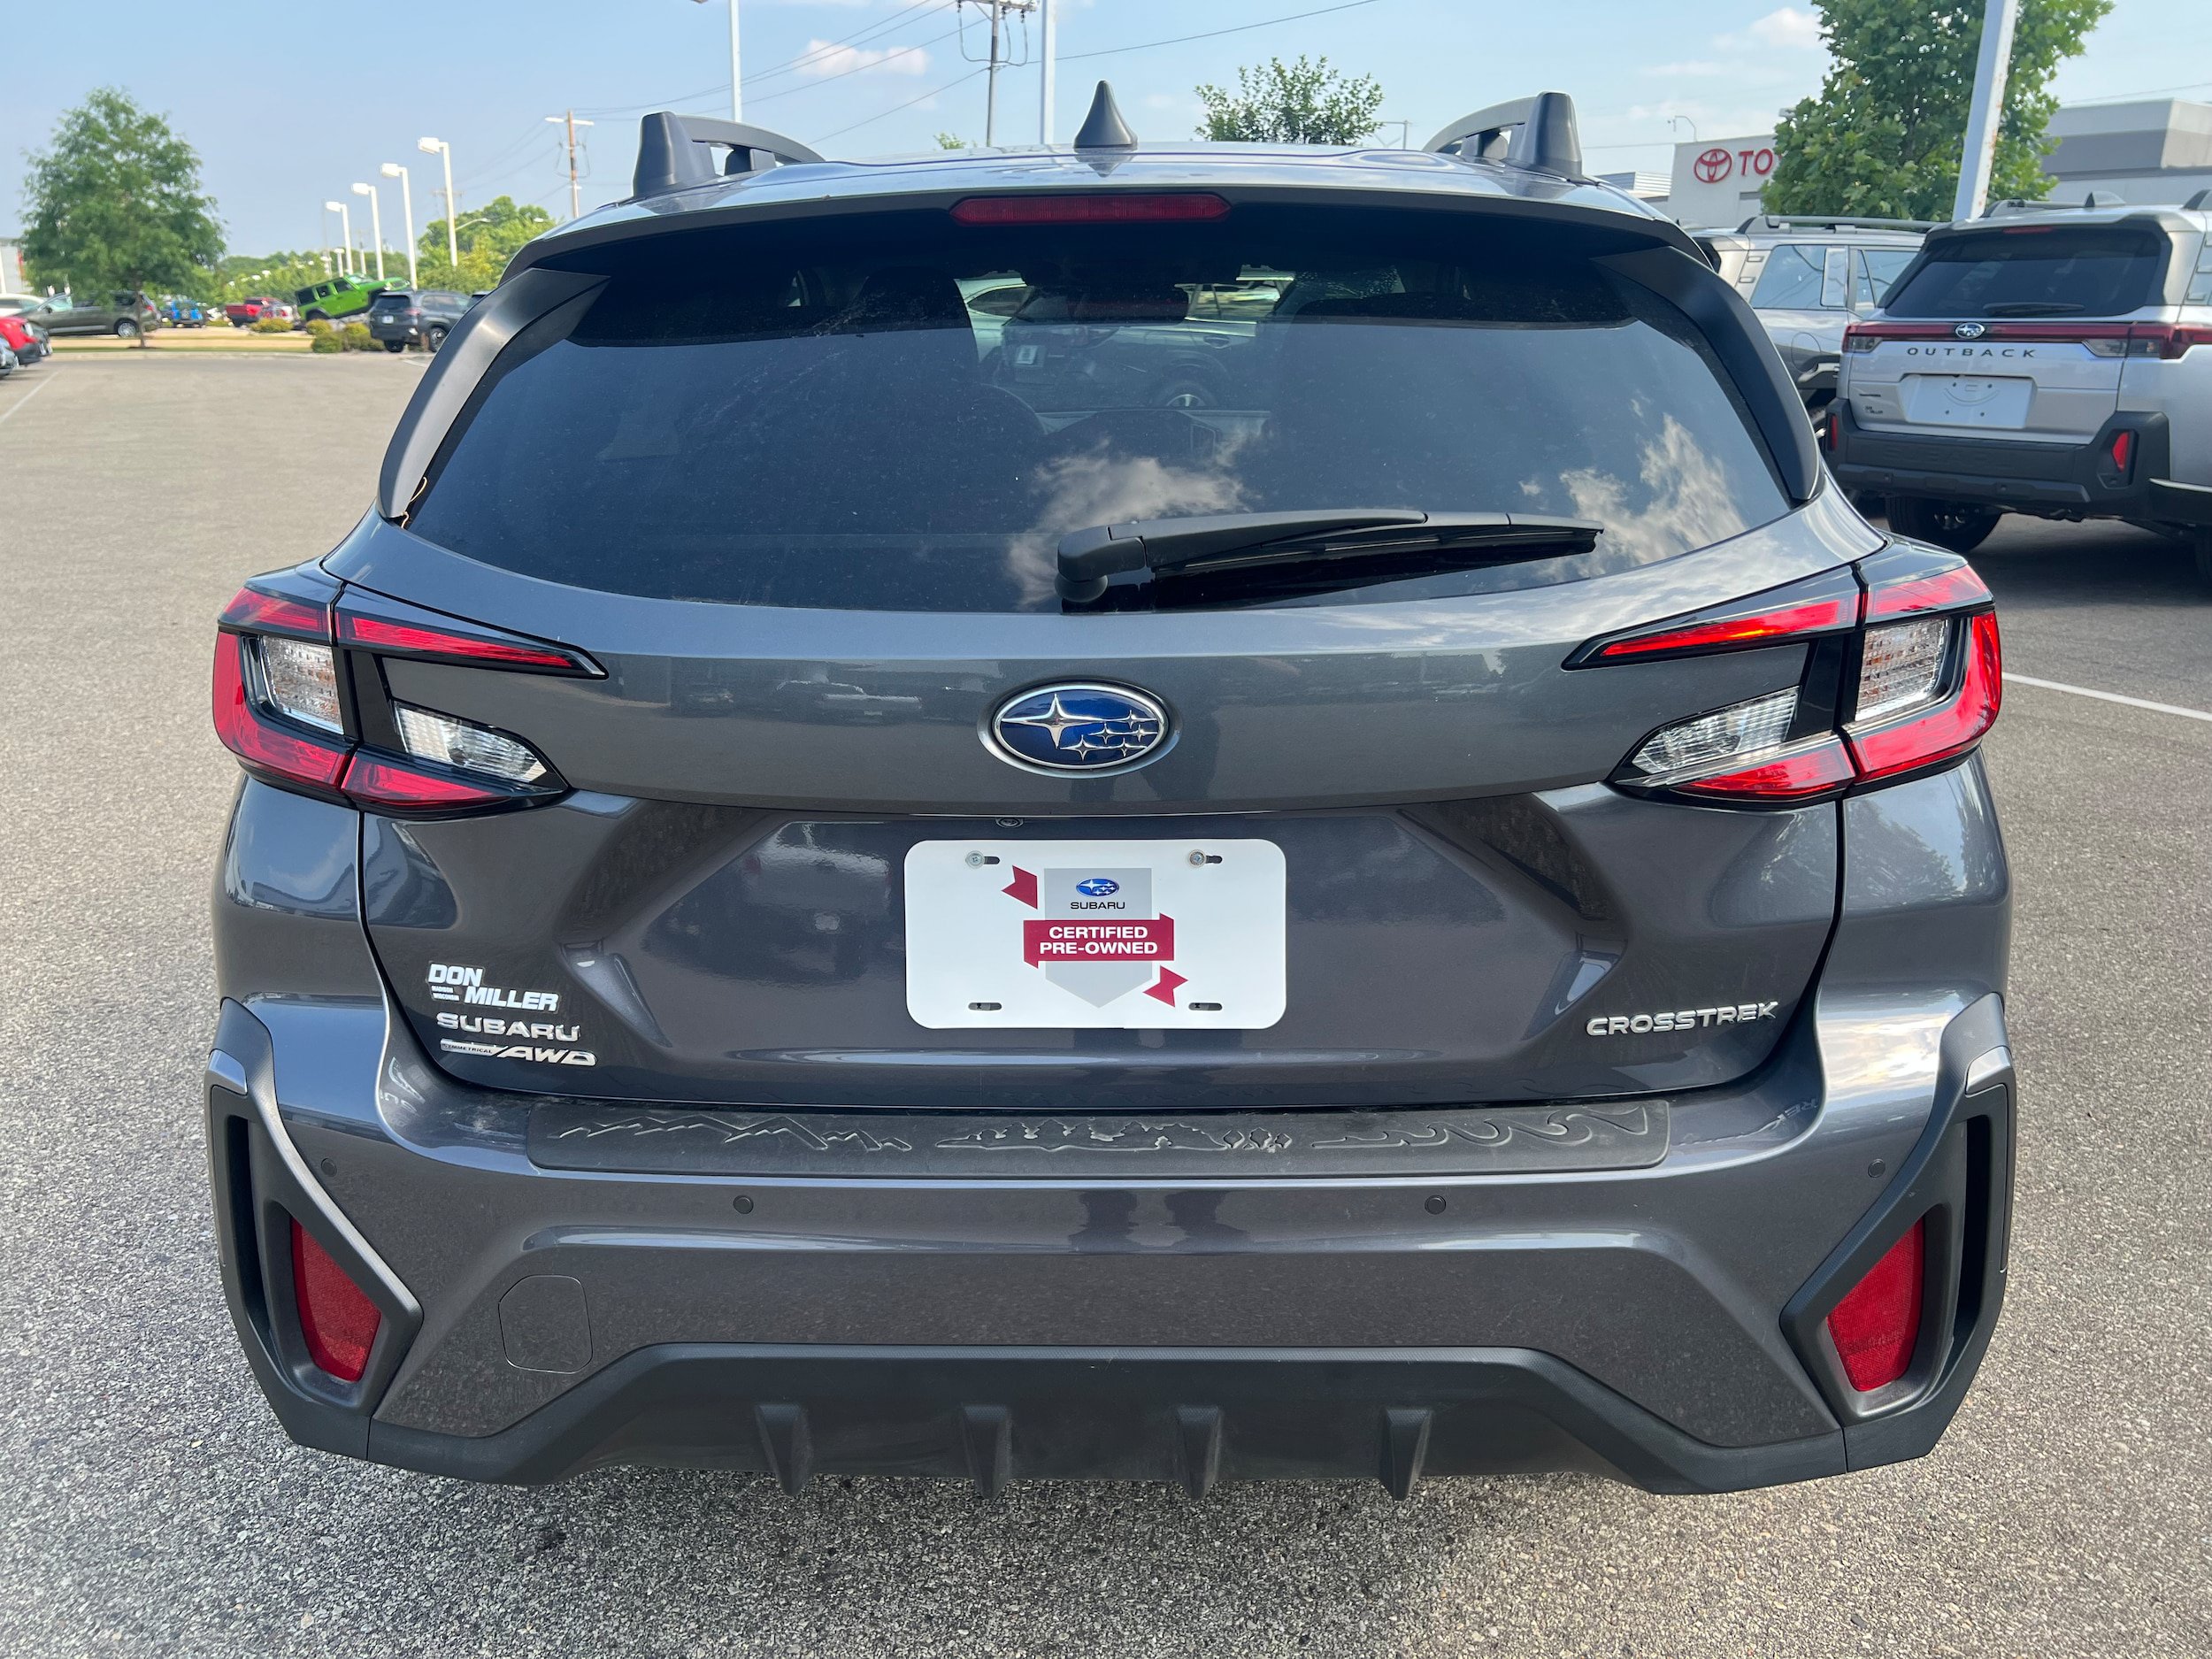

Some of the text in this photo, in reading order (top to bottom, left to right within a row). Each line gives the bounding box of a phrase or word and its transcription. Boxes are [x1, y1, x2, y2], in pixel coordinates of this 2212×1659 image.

[1908, 347, 2036, 358] OUTBACK
[1070, 901, 1125, 910] SUBARU
[1048, 926, 1148, 939] CERTIFIED
[1039, 941, 1158, 955] PRE-OWNED
[428, 964, 483, 987] DON
[464, 986, 560, 1012] MILLER
[436, 1011, 581, 1042] SUBARU
[1586, 1001, 1779, 1036] CROSSTREK
[496, 1045, 598, 1067] AWD
